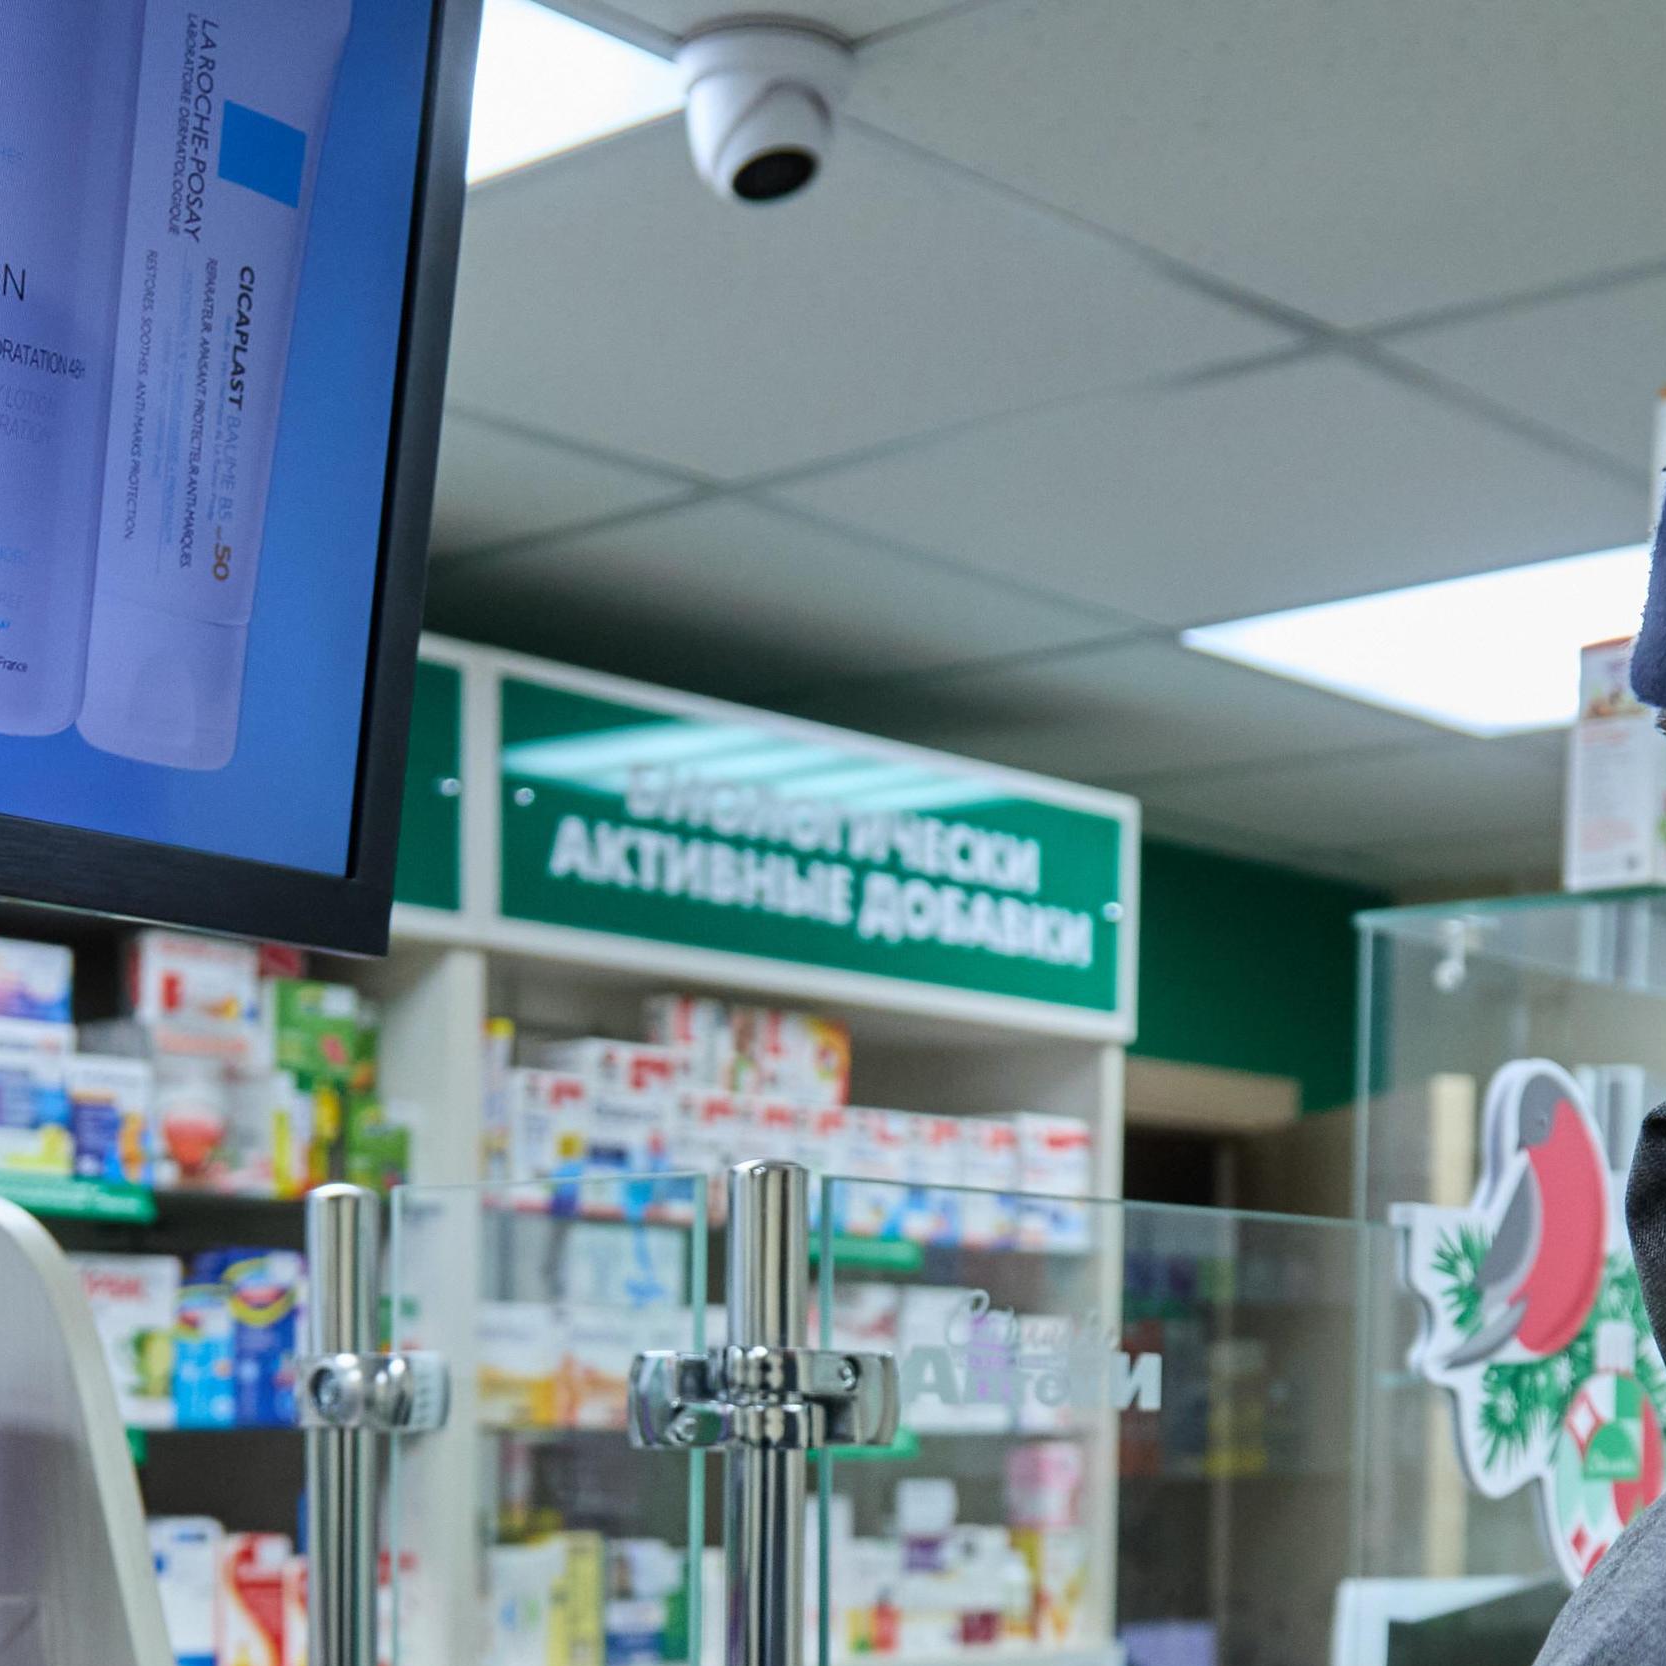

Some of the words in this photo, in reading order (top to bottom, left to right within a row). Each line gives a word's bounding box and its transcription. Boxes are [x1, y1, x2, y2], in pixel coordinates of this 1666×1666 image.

[227, 264, 255, 411] CICAPLAST
[547, 813, 854, 926] АКТИВНЫЕ
[856, 869, 1094, 970] ДОБАВКИ
